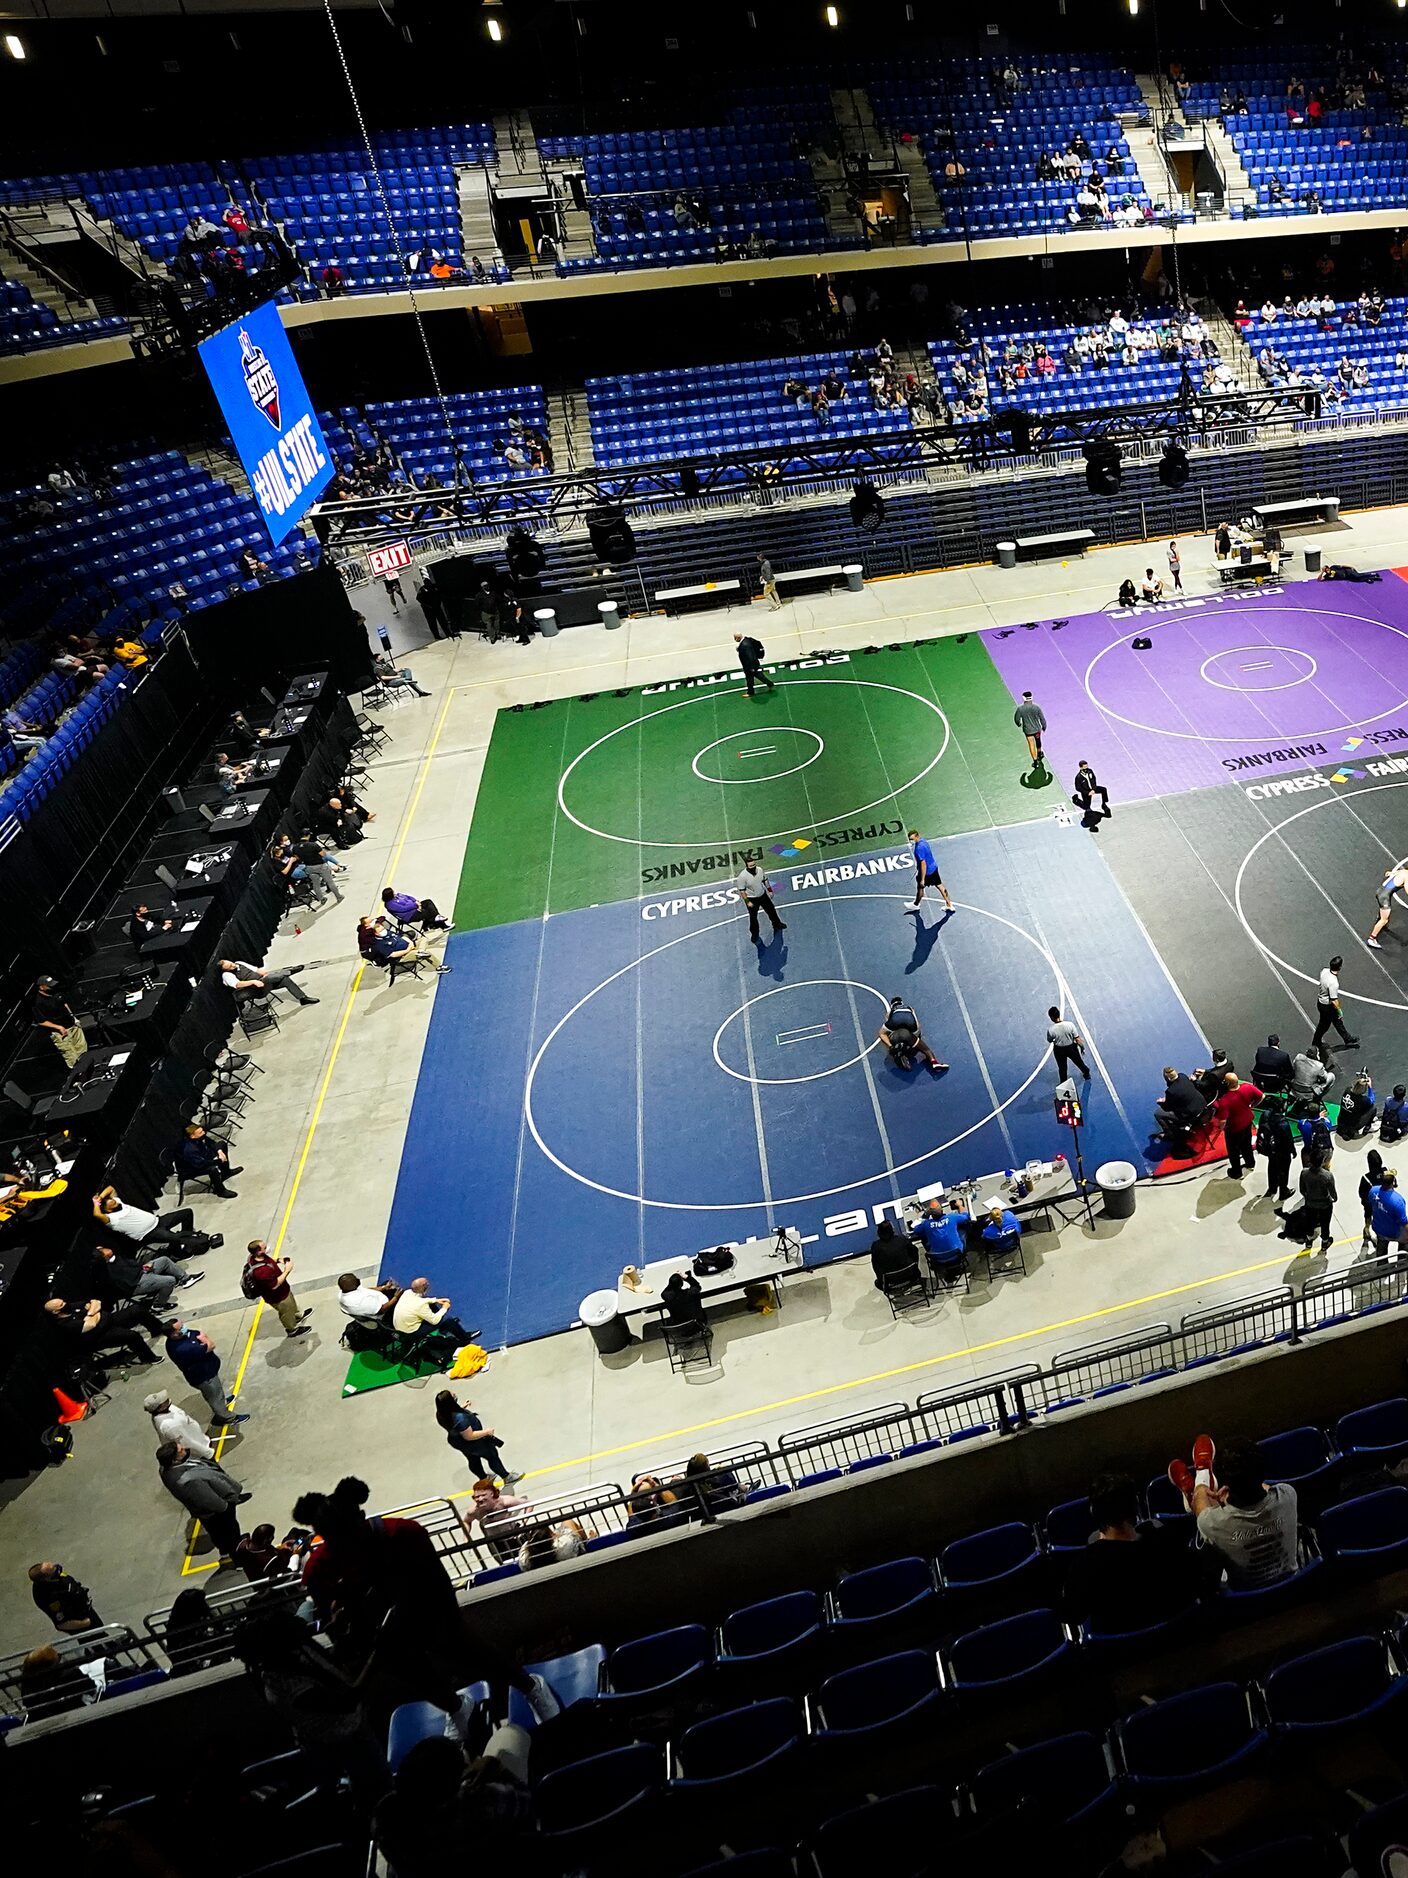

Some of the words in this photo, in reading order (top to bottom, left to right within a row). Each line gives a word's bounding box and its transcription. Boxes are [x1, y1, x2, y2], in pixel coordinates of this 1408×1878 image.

[247, 364, 276, 402] STATE
[252, 413, 326, 516] #UILSTATE
[369, 544, 409, 574] EXIT
[1221, 742, 1328, 771] FAIRBANKS
[1245, 772, 1331, 800] CYPRESS
[812, 820, 904, 849] CYPRESS
[641, 846, 764, 884] FAIRBANKS
[641, 887, 741, 921] CYPRESS
[791, 853, 914, 891] FAIRBANKS
[1063, 1090, 1072, 1099] 4
[929, 1217, 950, 1229] STAFF
